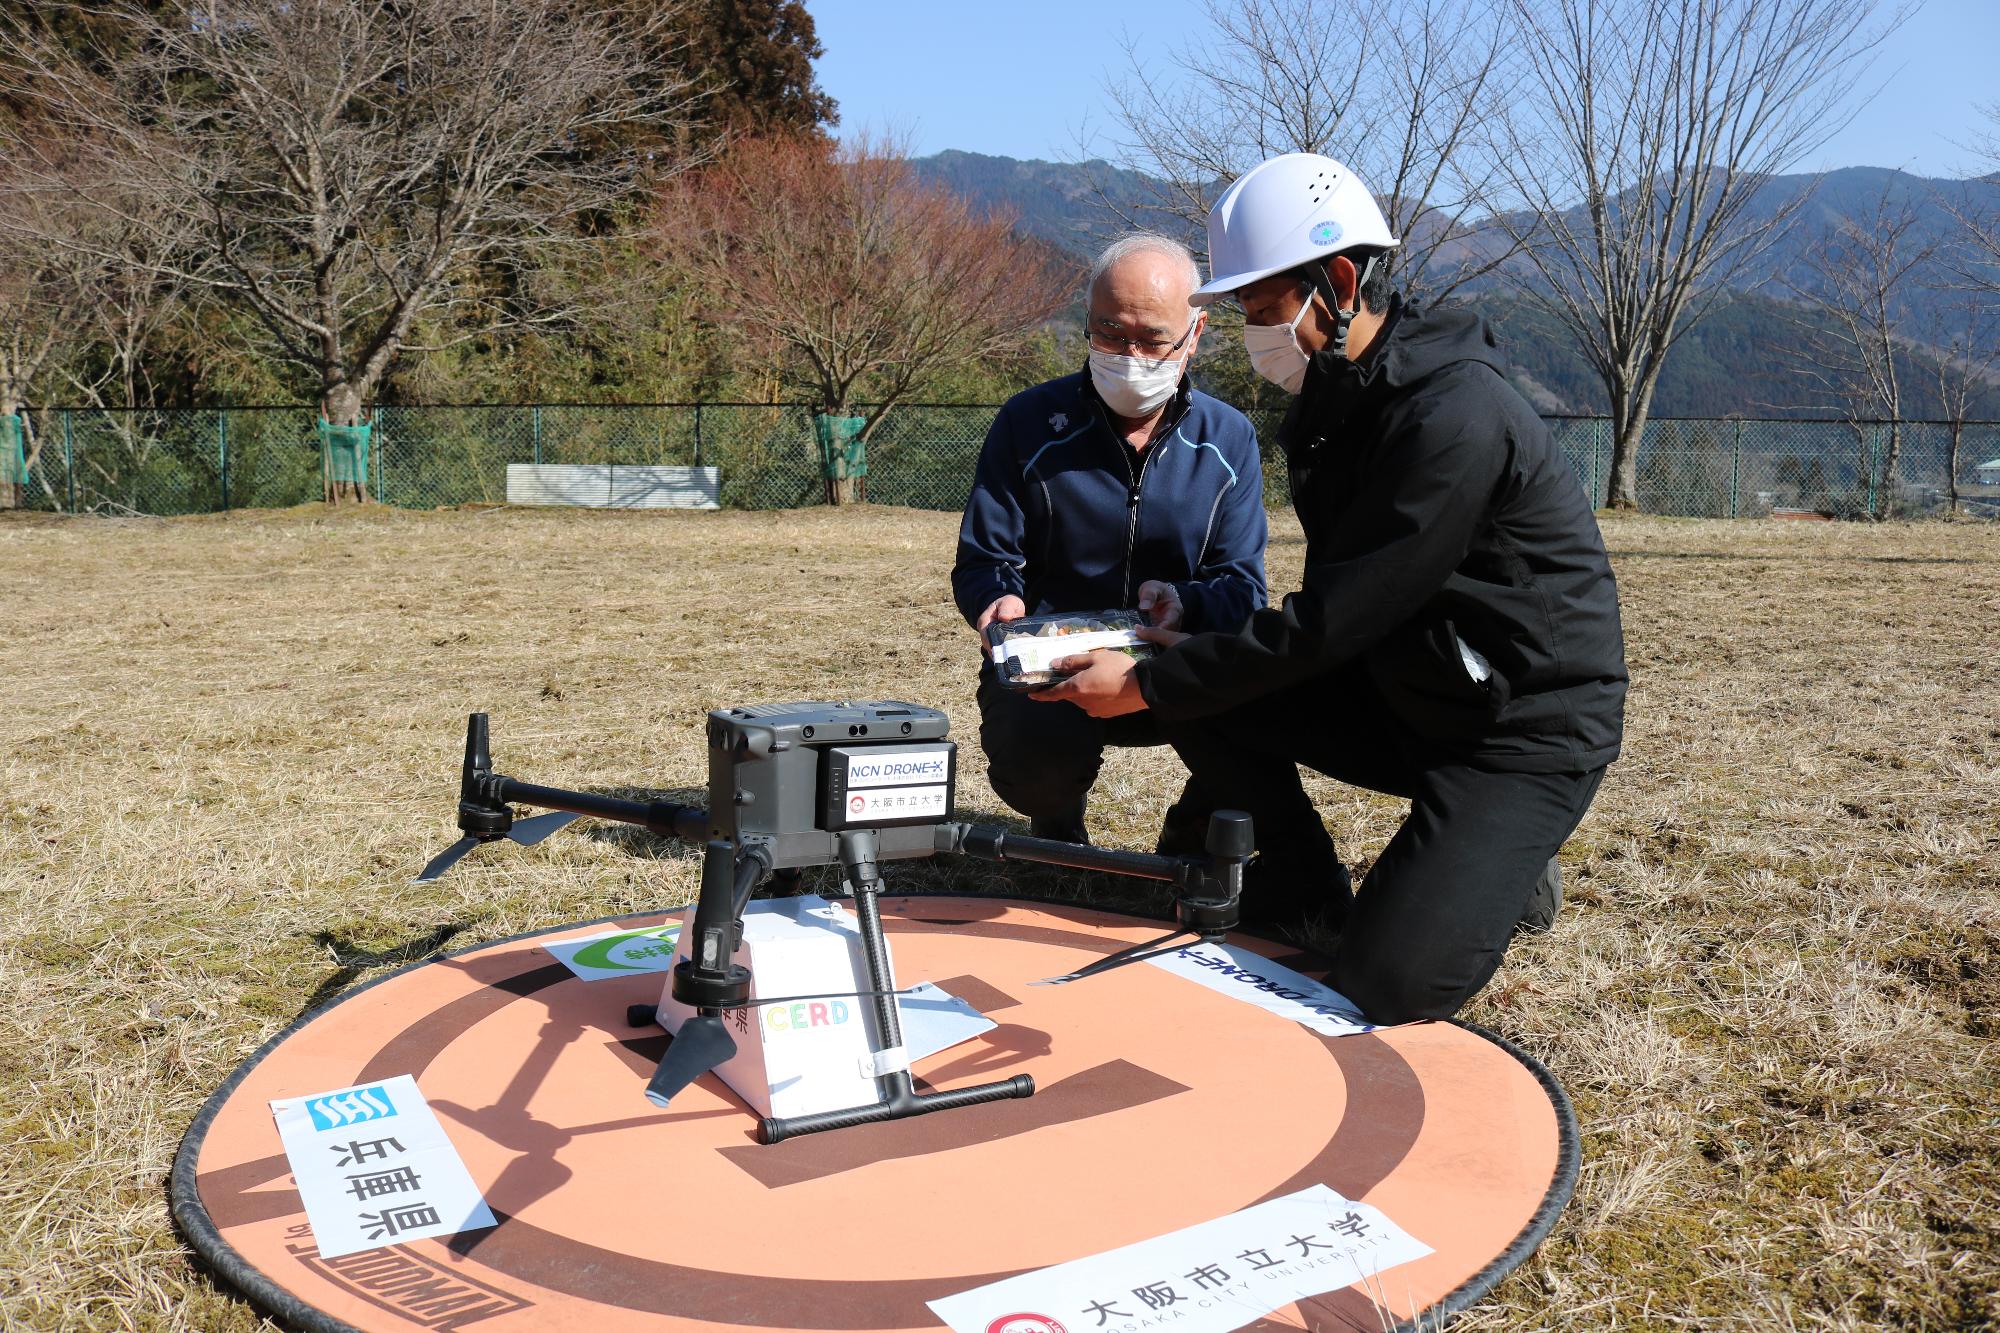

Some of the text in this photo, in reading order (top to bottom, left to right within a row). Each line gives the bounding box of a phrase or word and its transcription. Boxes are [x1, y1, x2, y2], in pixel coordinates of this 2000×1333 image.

[850, 762, 931, 777] NCN DRONE
[870, 794, 943, 808] 大阪市立大学
[767, 1000, 849, 1032] CERD
[328, 1136, 442, 1241] 兵庫県
[1081, 1210, 1371, 1327] 大阪市立大学
[1198, 1280, 1251, 1309] CITY
[1262, 1232, 1392, 1281] UNIVERSITY
